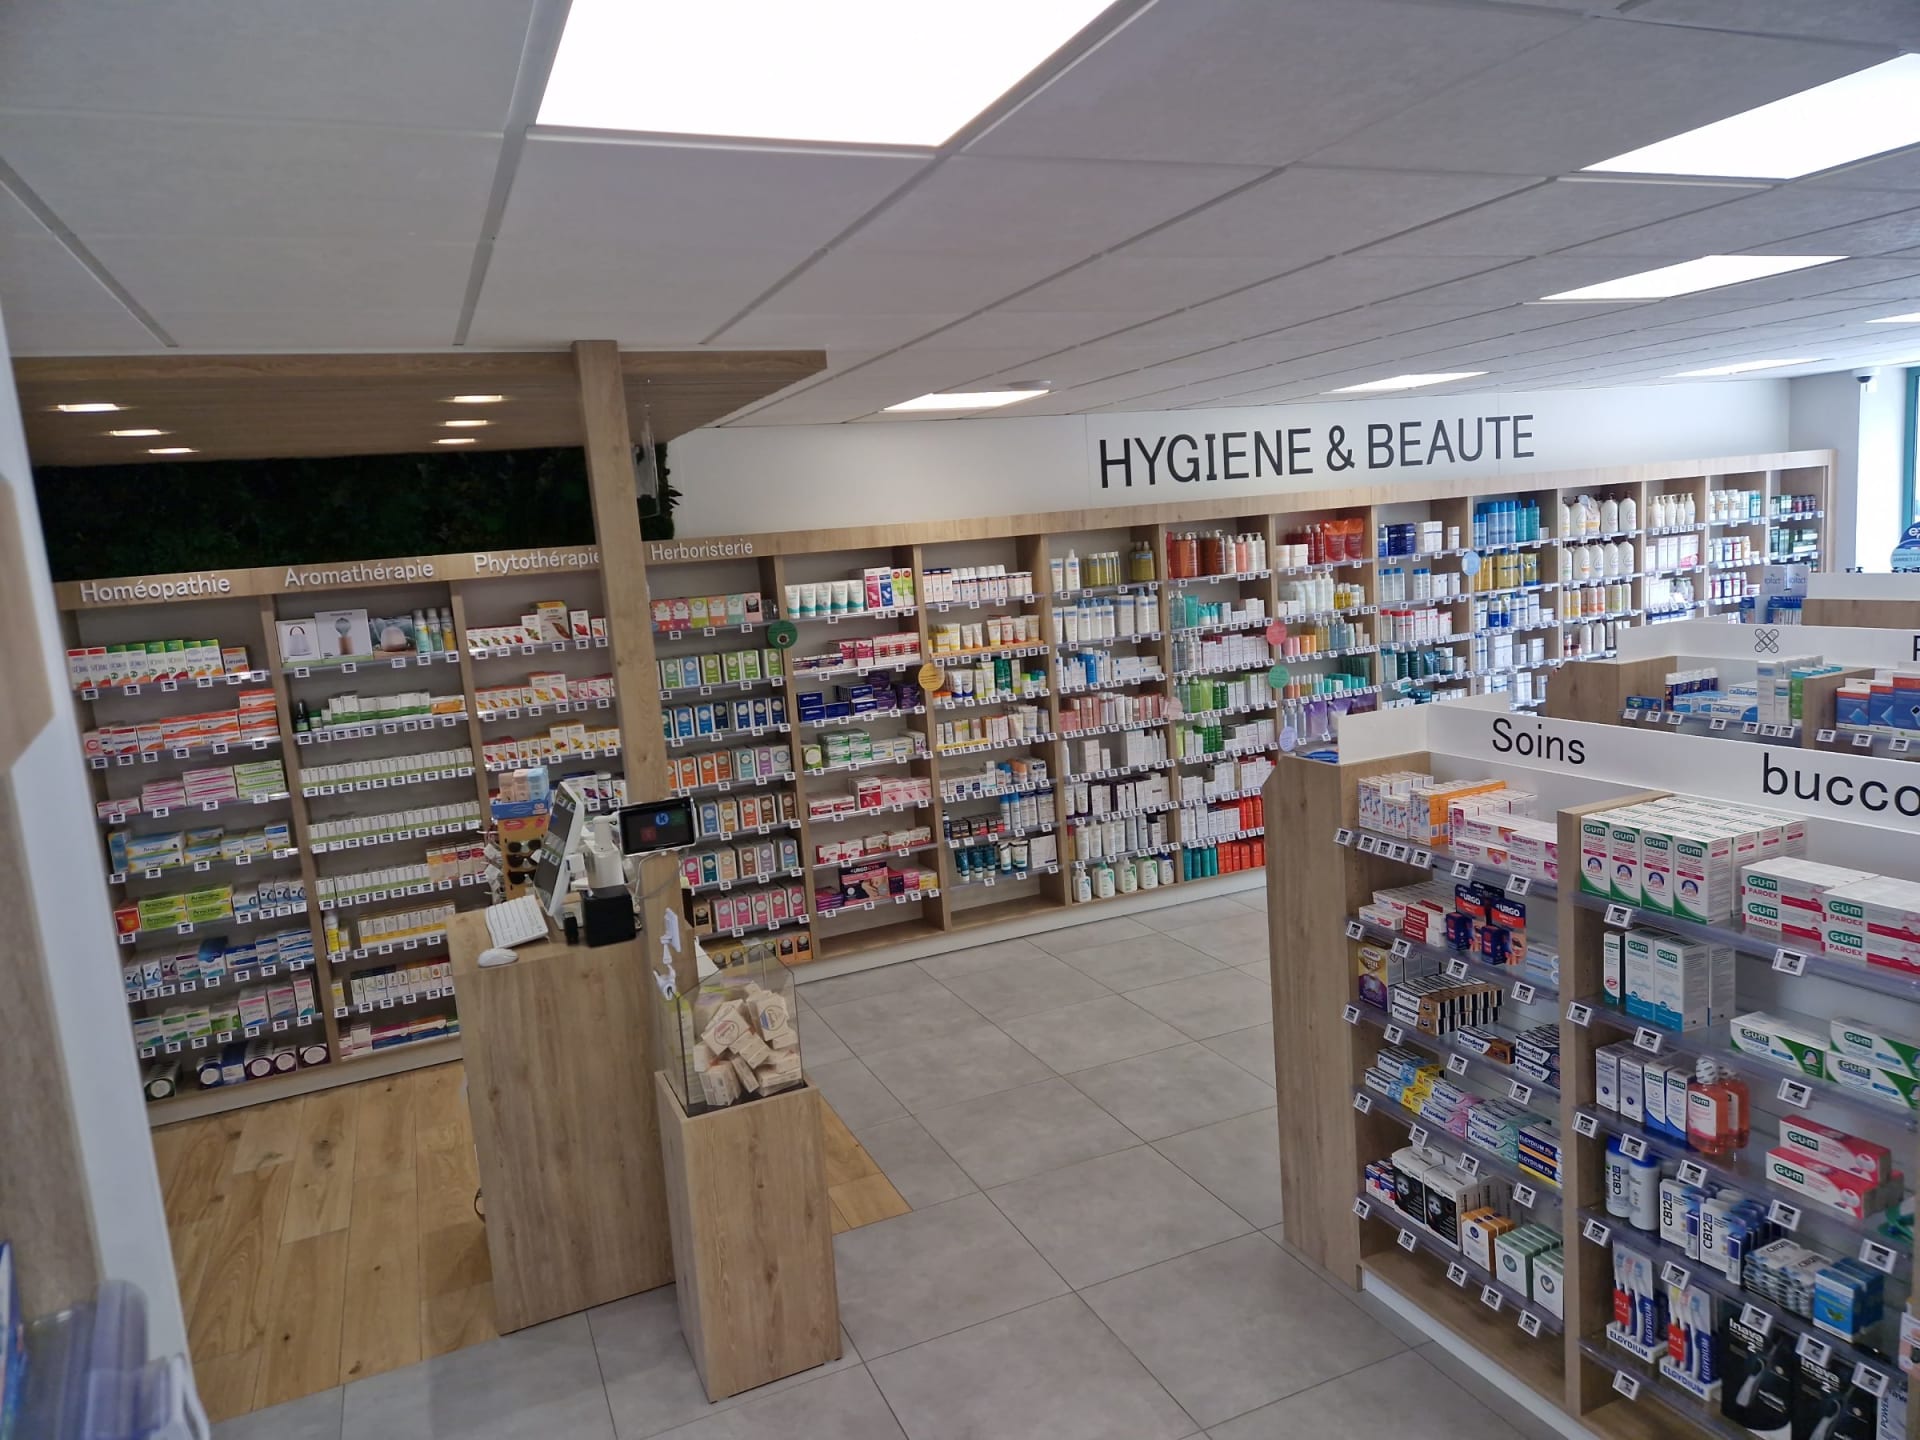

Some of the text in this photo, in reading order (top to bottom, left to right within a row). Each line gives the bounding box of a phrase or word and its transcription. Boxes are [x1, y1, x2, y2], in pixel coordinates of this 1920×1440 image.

[1100, 414, 1534, 488] HYGIENE & BEAUTE
[651, 539, 753, 560] Herboristerie
[284, 559, 434, 588] Aromathérapie
[80, 573, 230, 603] Homéopathie
[1492, 718, 1586, 765] Soins
[1763, 752, 1920, 817] bucco
[1584, 824, 1605, 836] GUM
[1613, 831, 1635, 842] GUM
[1645, 838, 1668, 850] GUM
[1678, 844, 1702, 856] GUM
[1463, 892, 1480, 906] URGO
[1748, 887, 1778, 898] PAROEX
[1500, 904, 1520, 916] URGO
[1748, 915, 1778, 927] PAROEX
[1830, 914, 1863, 926] PAROEX
[1829, 944, 1863, 956] PAROEX
[1459, 1032, 1485, 1049] Fixodent
[1518, 1040, 1544, 1058] Fixodent
[1516, 1058, 1544, 1076] Fixodent
[1434, 1086, 1458, 1103] Fixodent
[1423, 1106, 1446, 1122] Fixodent
[1472, 1114, 1498, 1131] Fixodent
[1472, 1130, 1498, 1148] Fixodent
[1520, 1134, 1544, 1151] ELGYDIUM
[1519, 1155, 1544, 1170] ELGYDIUM
[1612, 1172, 1622, 1195] CB12
[1663, 1198, 1672, 1226] CB12
[1703, 1220, 1712, 1249] CB12
[1730, 1318, 1764, 1343] Inava
[1610, 1330, 1648, 1358] ELGYDIUM
[1664, 1365, 1704, 1395] ELGYDIUM
